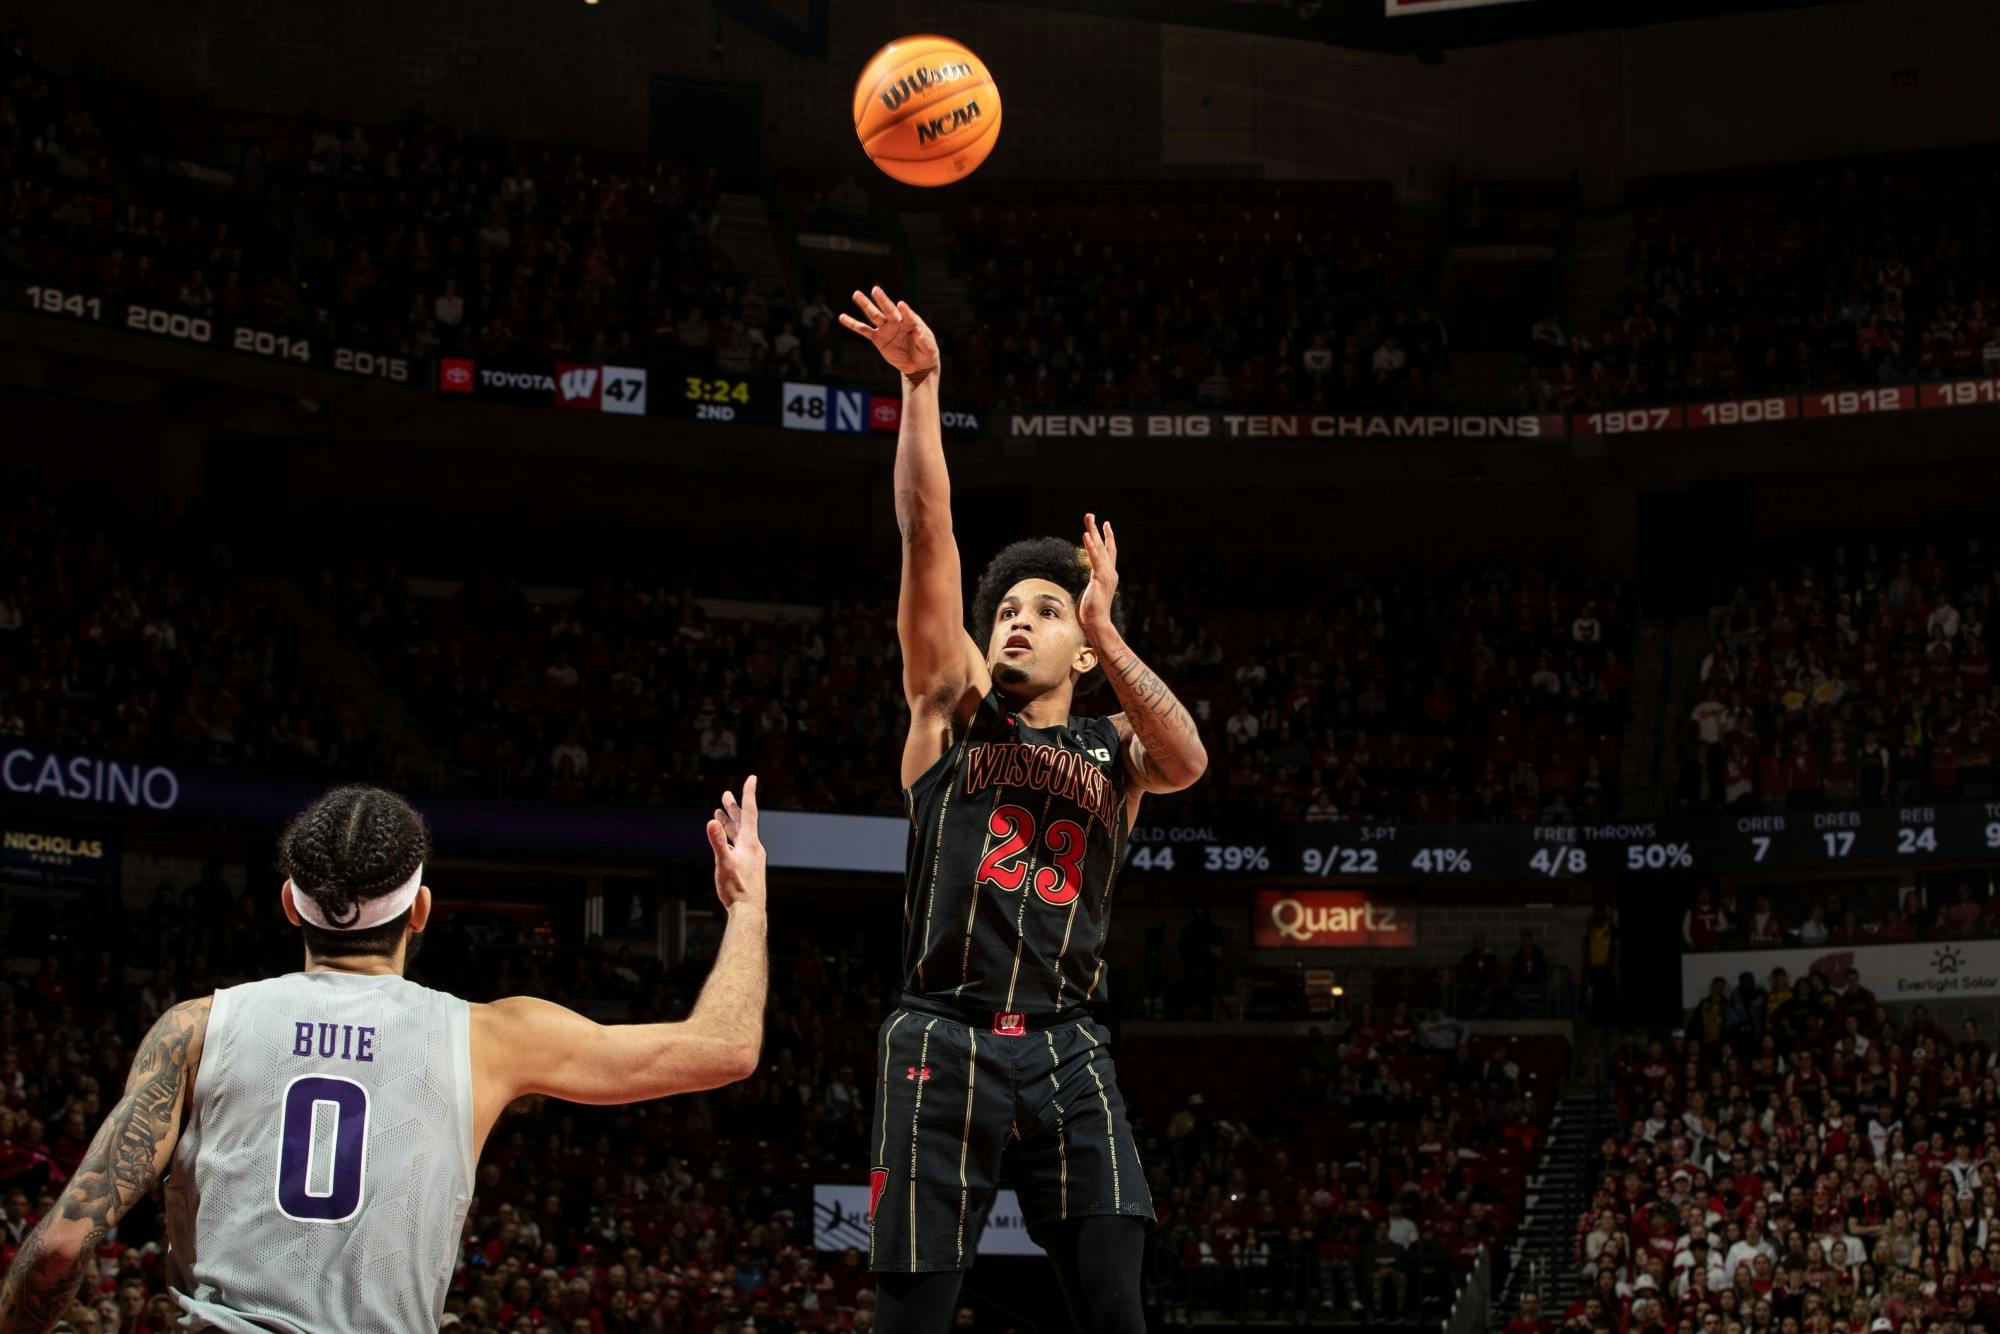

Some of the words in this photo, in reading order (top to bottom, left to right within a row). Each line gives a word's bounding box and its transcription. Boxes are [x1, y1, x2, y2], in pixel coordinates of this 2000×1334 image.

[881, 62, 973, 112] Wilson
[916, 101, 982, 145] NCAA
[26, 285, 101, 320] 1941
[127, 305, 211, 342] 2000
[234, 327, 310, 362] 2014
[334, 348, 408, 381] 2015
[481, 369, 556, 391] TOYOTA
[605, 378, 643, 402] 47
[686, 377, 750, 403] 3:24
[1937, 379, 2000, 406] 191
[696, 404, 735, 422] 2ND
[786, 395, 824, 419] 48
[1701, 398, 1786, 425] 1908
[1820, 387, 1901, 415] 1912
[941, 411, 978, 429] OTA
[1011, 415, 1134, 437] MEN'S
[1147, 415, 1211, 437] BIG
[1223, 415, 1299, 437] TEN
[1311, 415, 1541, 438] CHAMPIONS
[1588, 408, 1671, 435] 1907
[2, 748, 179, 810] CASINO
[967, 742, 1118, 840] WISCONSIN
[1737, 815, 1785, 833] OREB
[1814, 811, 1862, 830] DREB
[1900, 807, 1936, 824] REB
[3, 831, 104, 858] NICHOLAS
[1133, 826, 1166, 842] ELD
[1168, 826, 1219, 842] GOAL
[1359, 826, 1397, 842] 3-PT
[1533, 826, 1577, 843] FREE
[1584, 823, 1657, 841] THROWS
[1823, 831, 1855, 858] 17
[1897, 826, 1938, 854] 24
[974, 804, 1087, 906] 23
[1204, 845, 1270, 871] 39%
[1302, 847, 1378, 877] 9/22
[1410, 847, 1473, 873] 41%
[1529, 846, 1588, 877] 4/8
[1626, 843, 1693, 870] 50%
[1752, 837, 1770, 863] 7
[1272, 899, 1397, 941] Quartz
[1898, 977, 1958, 993] Everlight
[1962, 976, 1997, 990] Solar
[293, 1021, 375, 1062] BUIE
[910, 1142, 918, 1178] EQUALITY
[920, 1032, 929, 1068] FORWARD
[275, 1073, 370, 1224] 0
[1108, 1136, 1118, 1170] FORWARD
[1113, 1170, 1121, 1209] WISCONSIN
